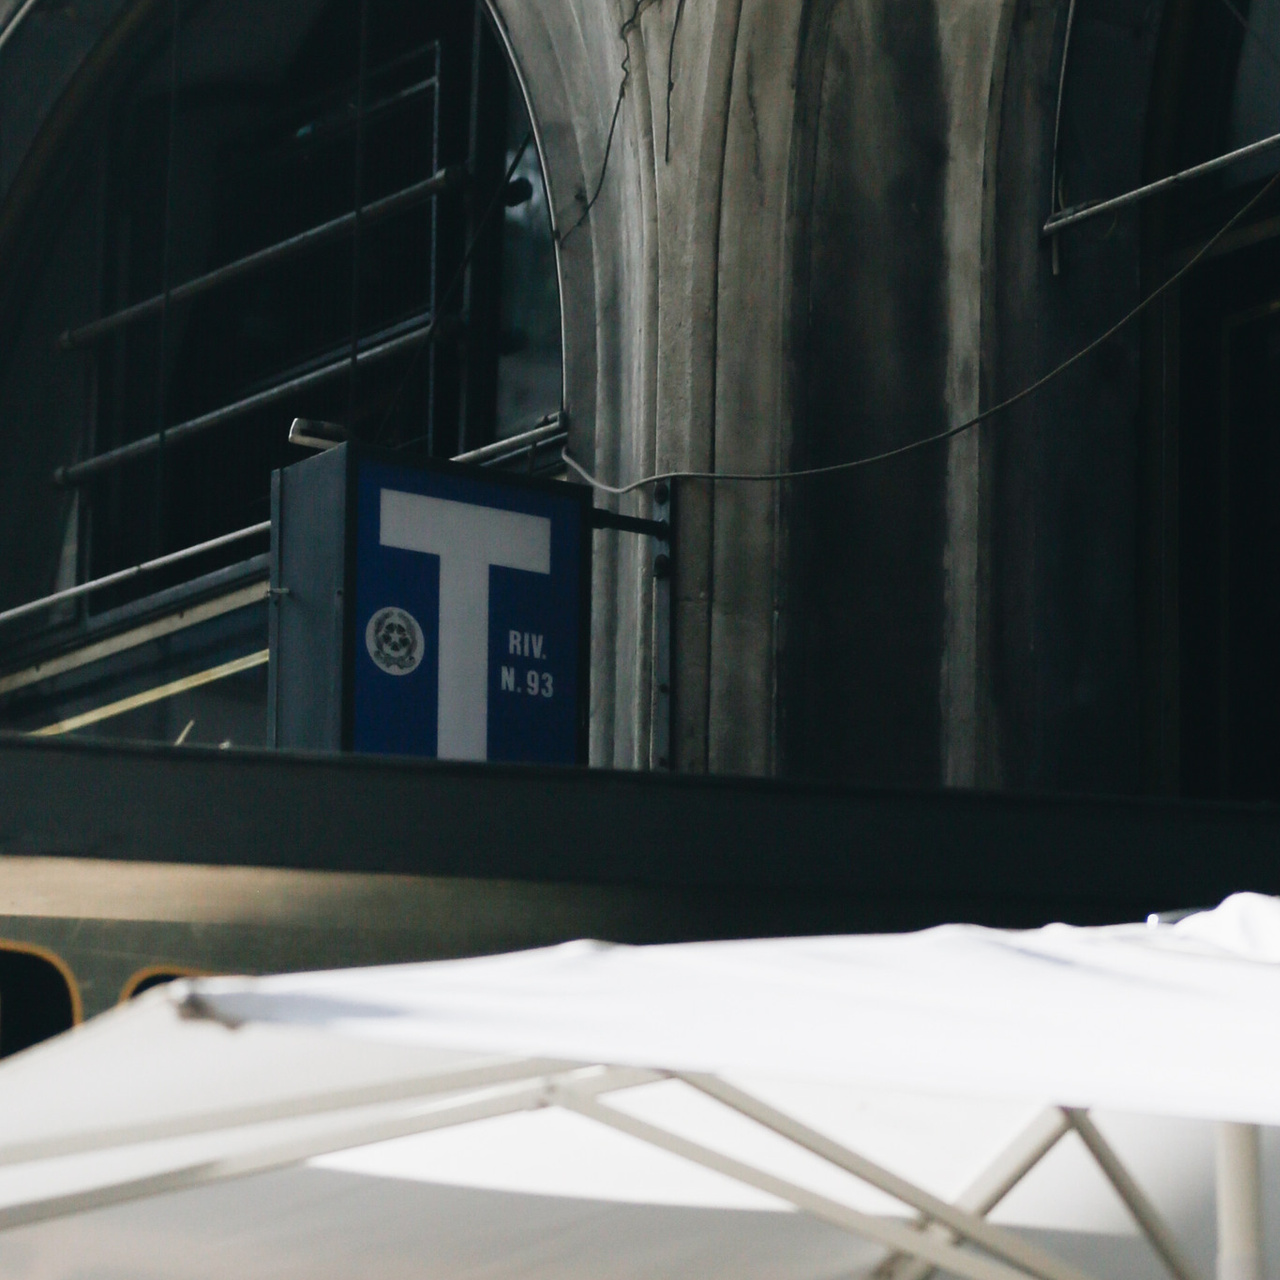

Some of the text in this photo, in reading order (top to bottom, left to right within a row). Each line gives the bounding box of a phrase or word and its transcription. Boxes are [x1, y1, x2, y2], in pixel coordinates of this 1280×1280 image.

[379, 488, 552, 761] T
[508, 629, 548, 660] RIV.
[500, 666, 554, 699] N. 93
